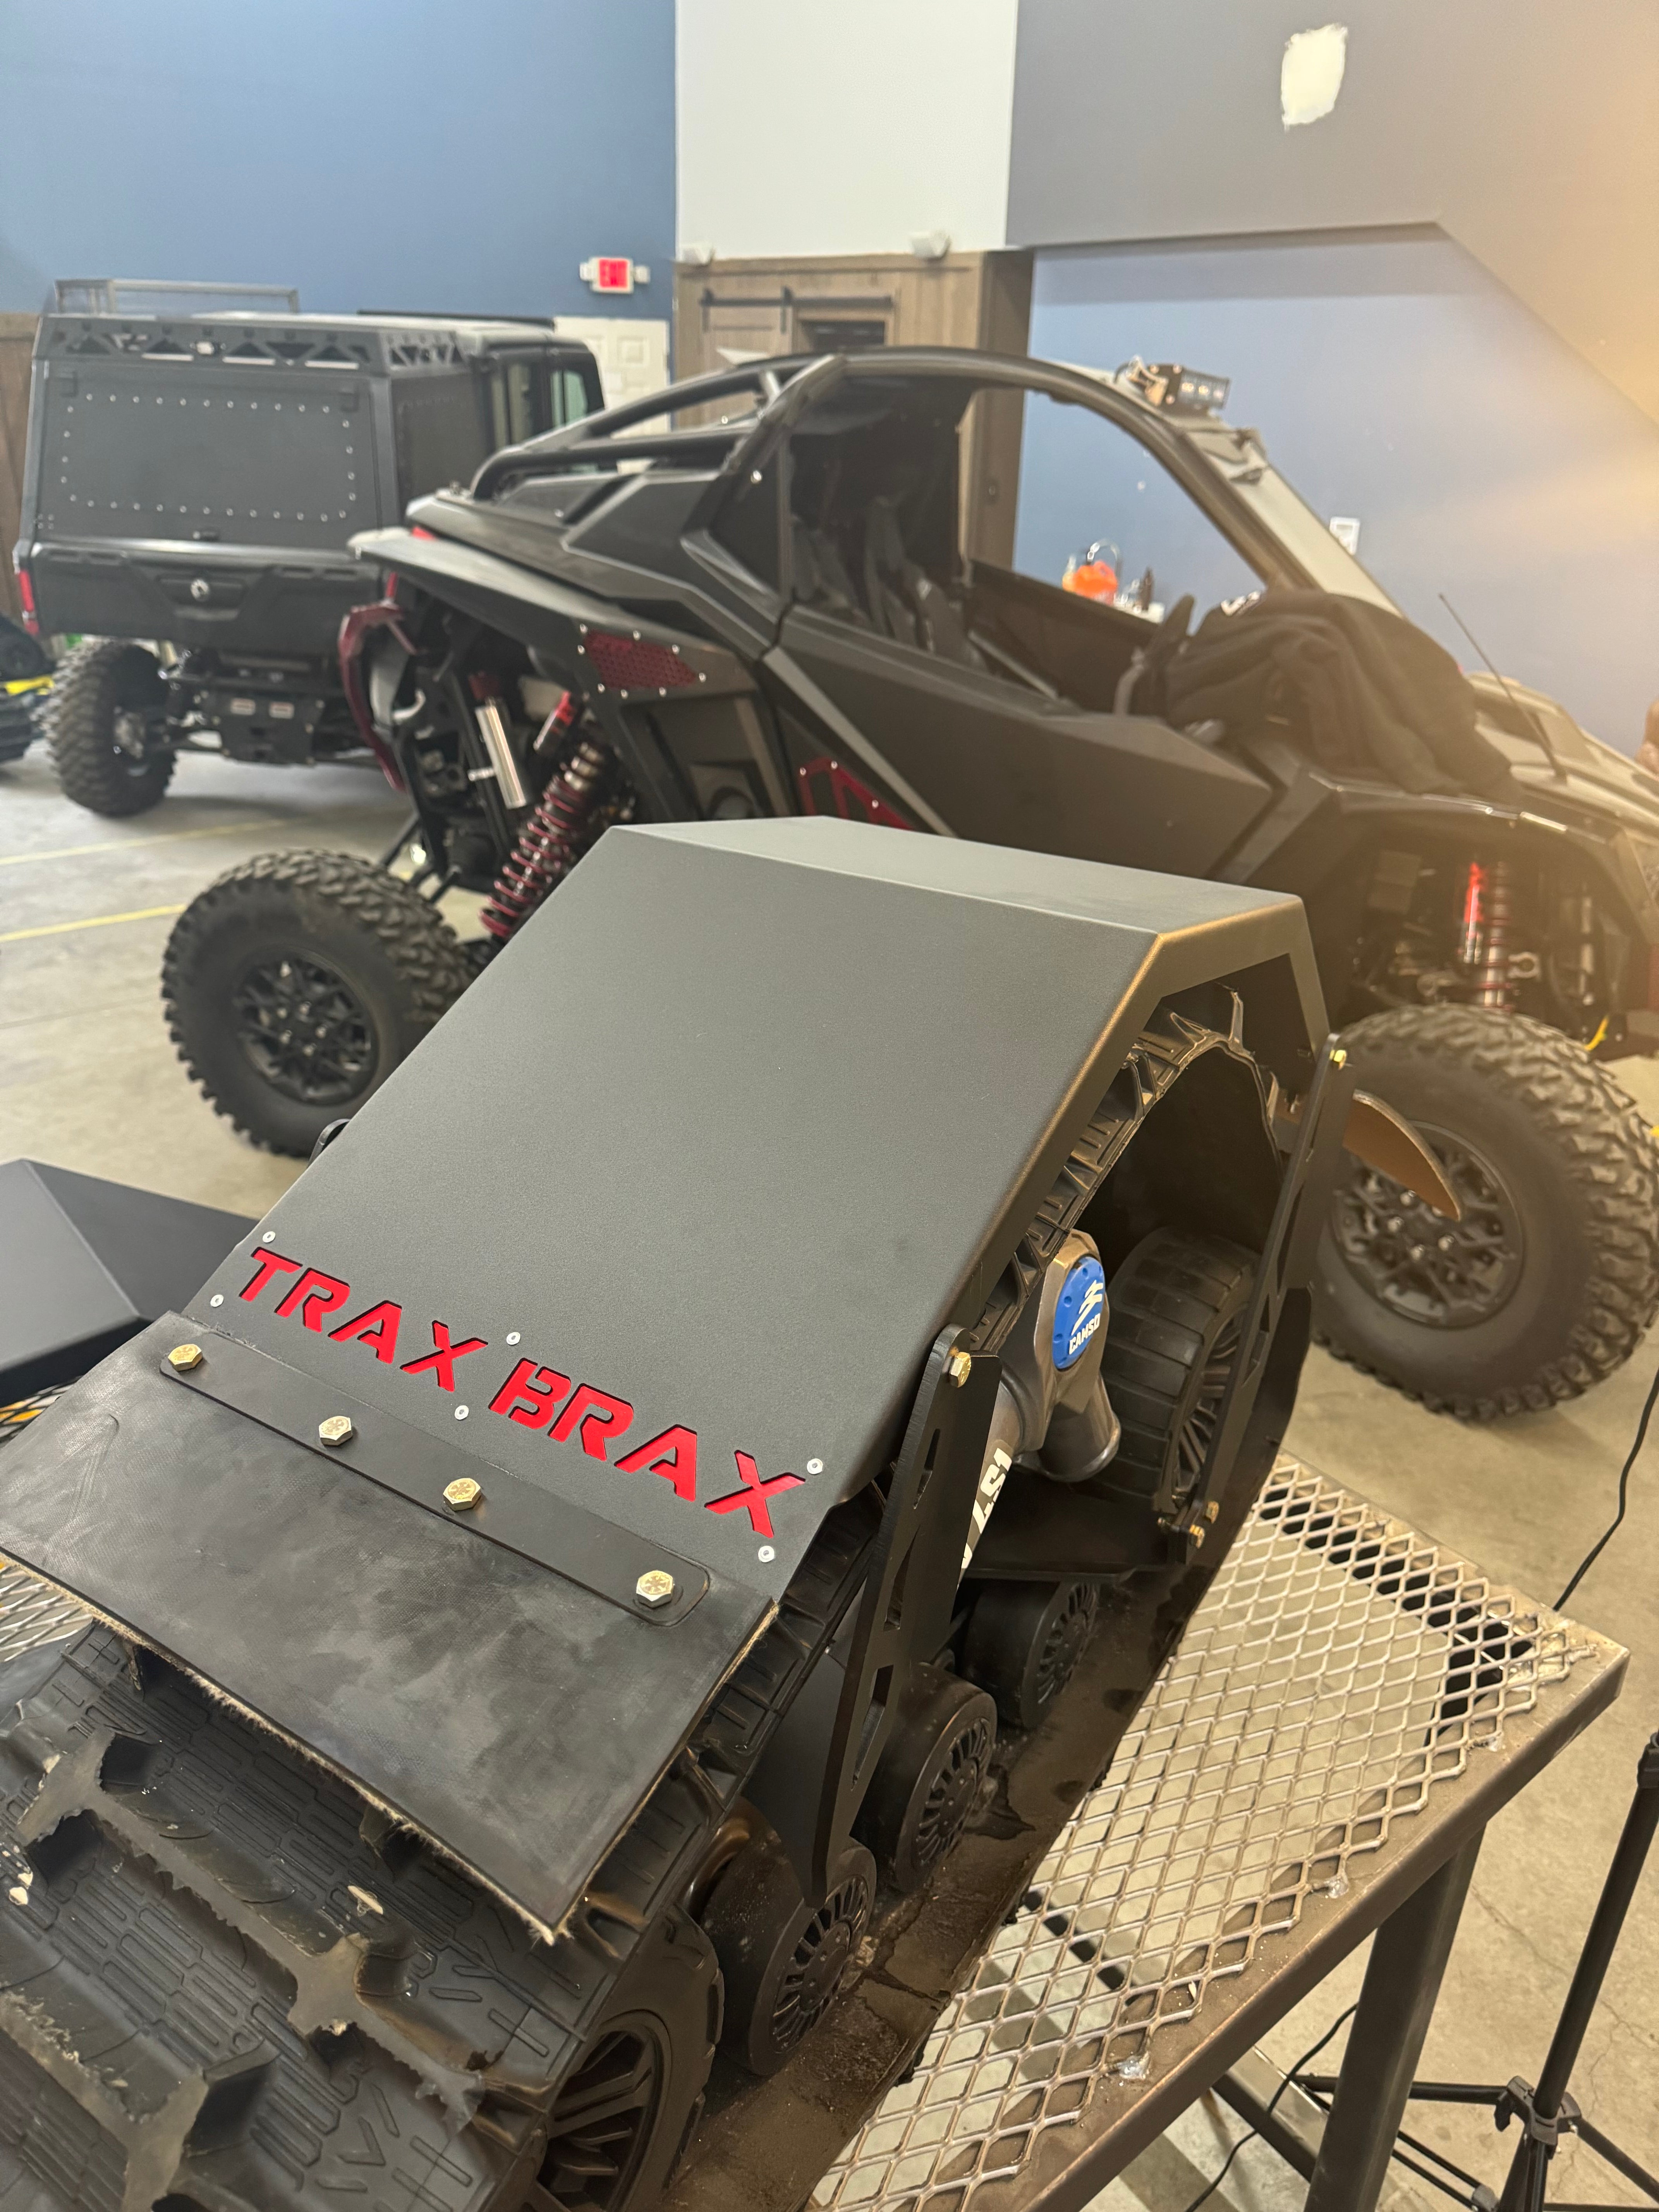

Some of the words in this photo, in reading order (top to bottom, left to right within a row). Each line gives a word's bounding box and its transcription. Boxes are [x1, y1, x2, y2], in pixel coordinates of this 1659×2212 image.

[239, 1247, 489, 1393] TRAX
[489, 1357, 806, 1539] BRAX
[1069, 1313, 1101, 1355] CAMSO
